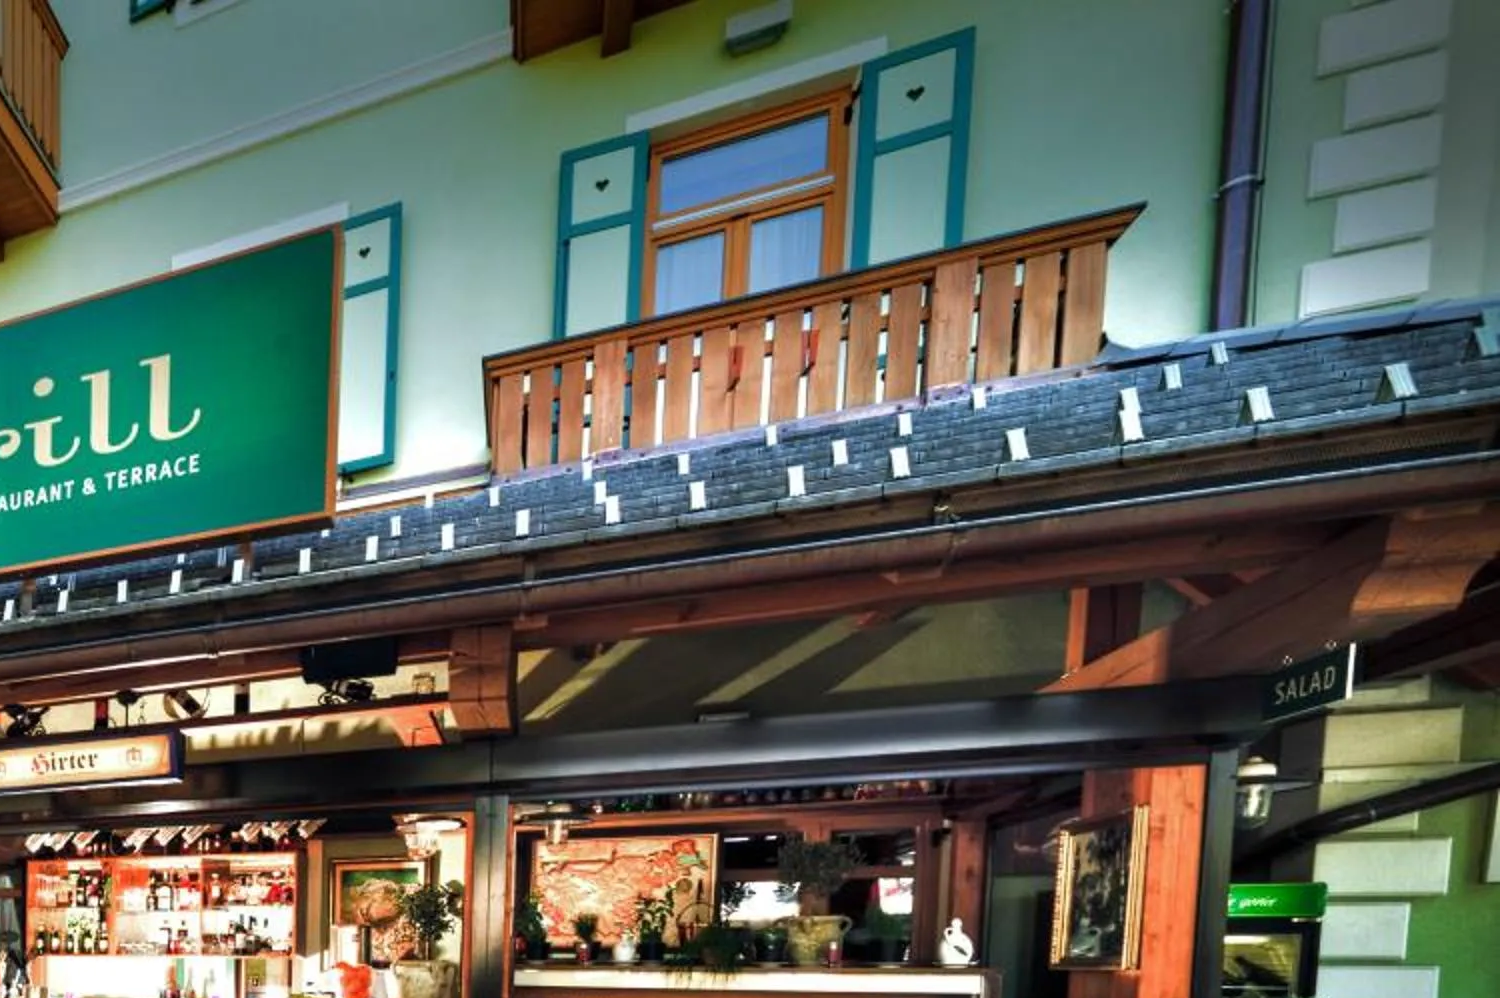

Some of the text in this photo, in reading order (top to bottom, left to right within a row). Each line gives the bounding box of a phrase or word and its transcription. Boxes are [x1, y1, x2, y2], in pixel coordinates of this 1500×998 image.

[81, 477, 97, 496] &
[103, 453, 201, 491] TERRACE
[1273, 665, 1337, 705] SALAD
[30, 751, 99, 776] Hirter
